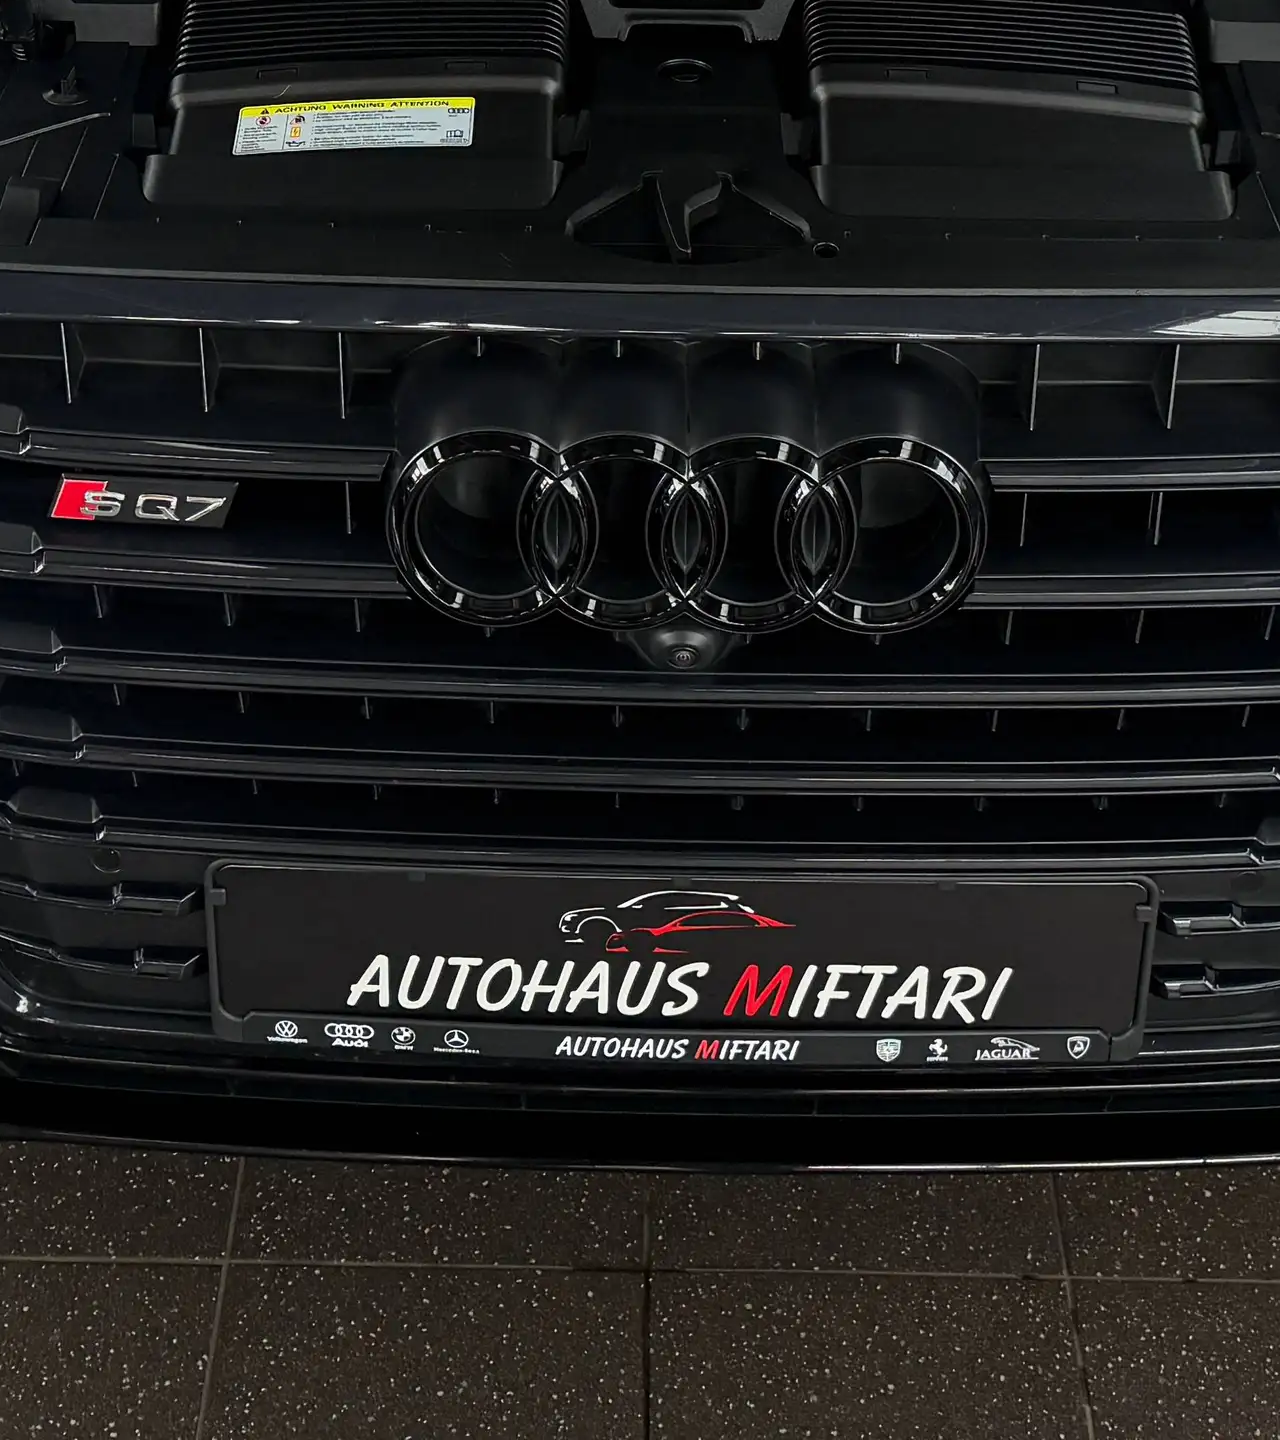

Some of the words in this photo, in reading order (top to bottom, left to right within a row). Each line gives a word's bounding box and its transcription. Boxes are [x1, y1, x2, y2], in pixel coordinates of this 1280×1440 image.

[275, 105, 327, 114] ACHTUNG
[332, 102, 385, 110] WARNING
[390, 100, 450, 108] ATTENTION
[346, 954, 710, 1017] AUTOHAUS
[723, 964, 1013, 1024] MIFTARI
[332, 1037, 369, 1048] Audi
[555, 1035, 690, 1059] AUTOHAUS
[694, 1039, 800, 1061] MIFTARI
[975, 1048, 1031, 1060] JAGUAR
